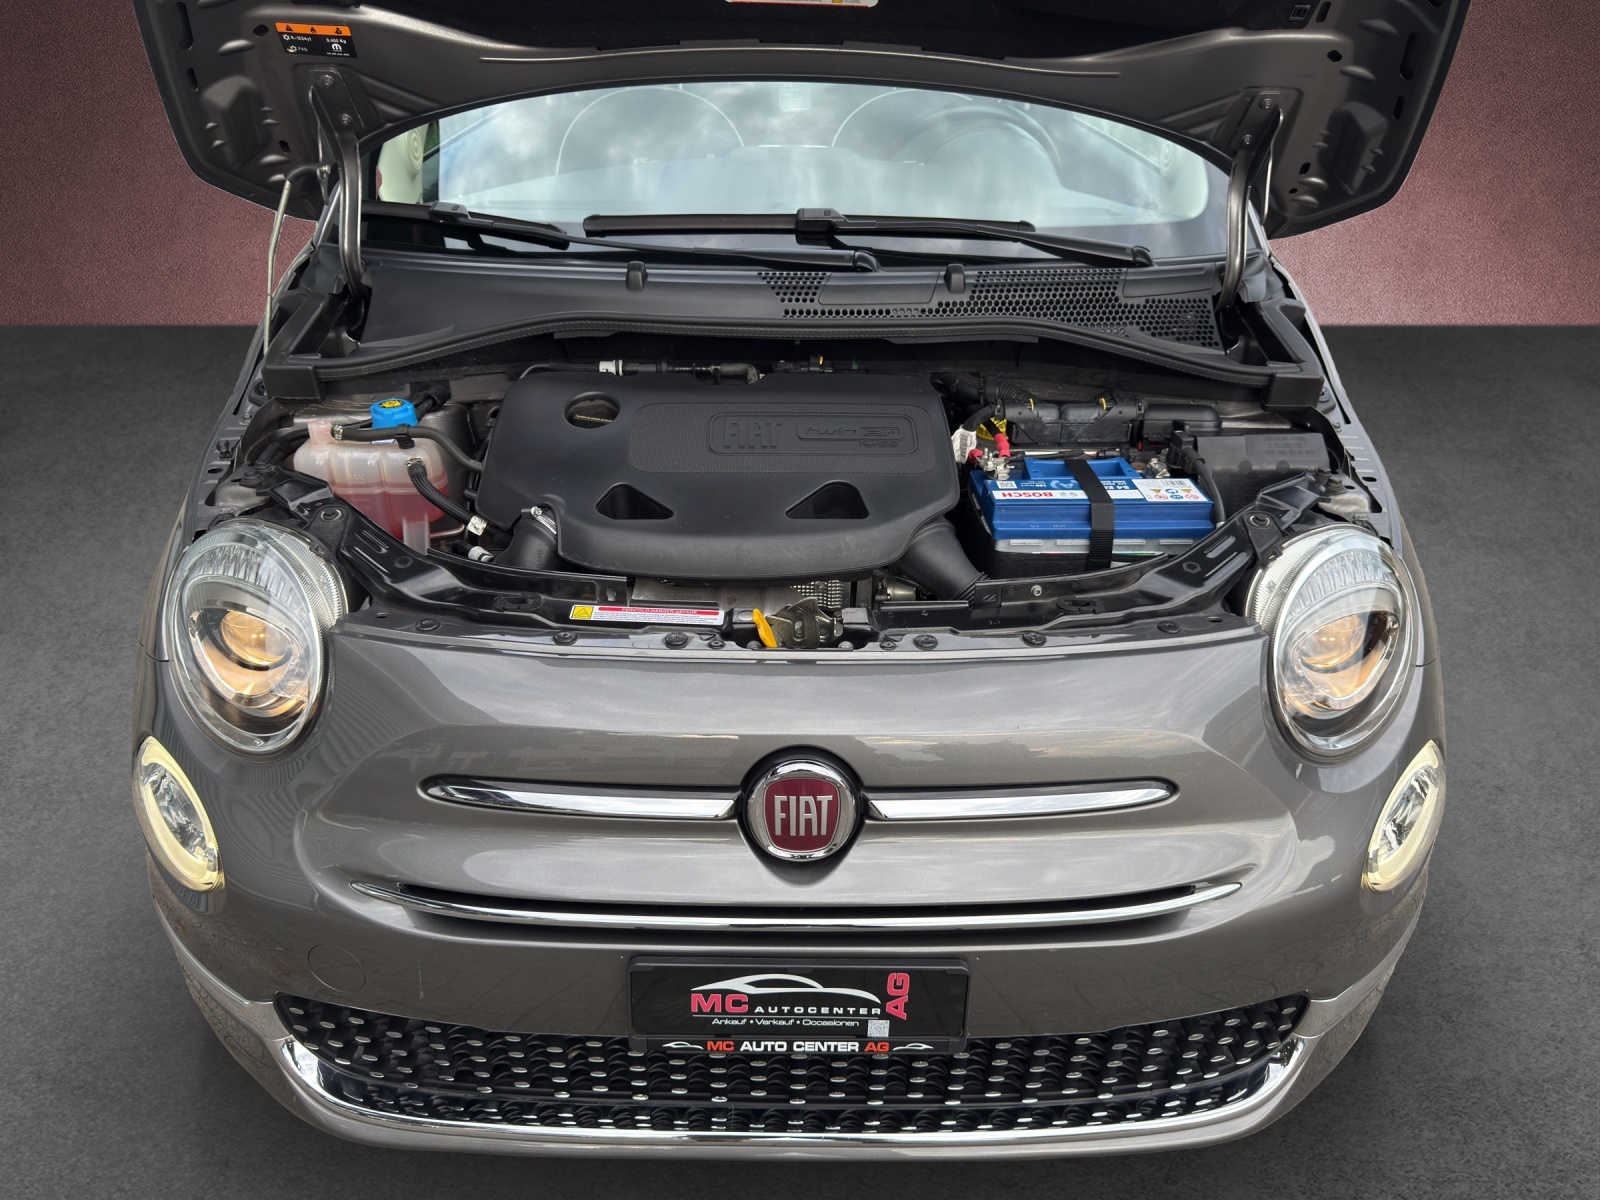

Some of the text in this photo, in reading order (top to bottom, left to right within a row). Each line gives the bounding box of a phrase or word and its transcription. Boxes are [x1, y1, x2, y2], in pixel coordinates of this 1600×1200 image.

[723, 420, 782, 448] FIAT
[774, 795, 833, 836] FIAT
[690, 993, 882, 1015] MC AUTOCENTER
[885, 972, 910, 1020] AG
[755, 1018, 795, 1026] Verkauf
[802, 1018, 860, 1027] Occasionen
[707, 1040, 890, 1053] MC AUTO CENTER AG
